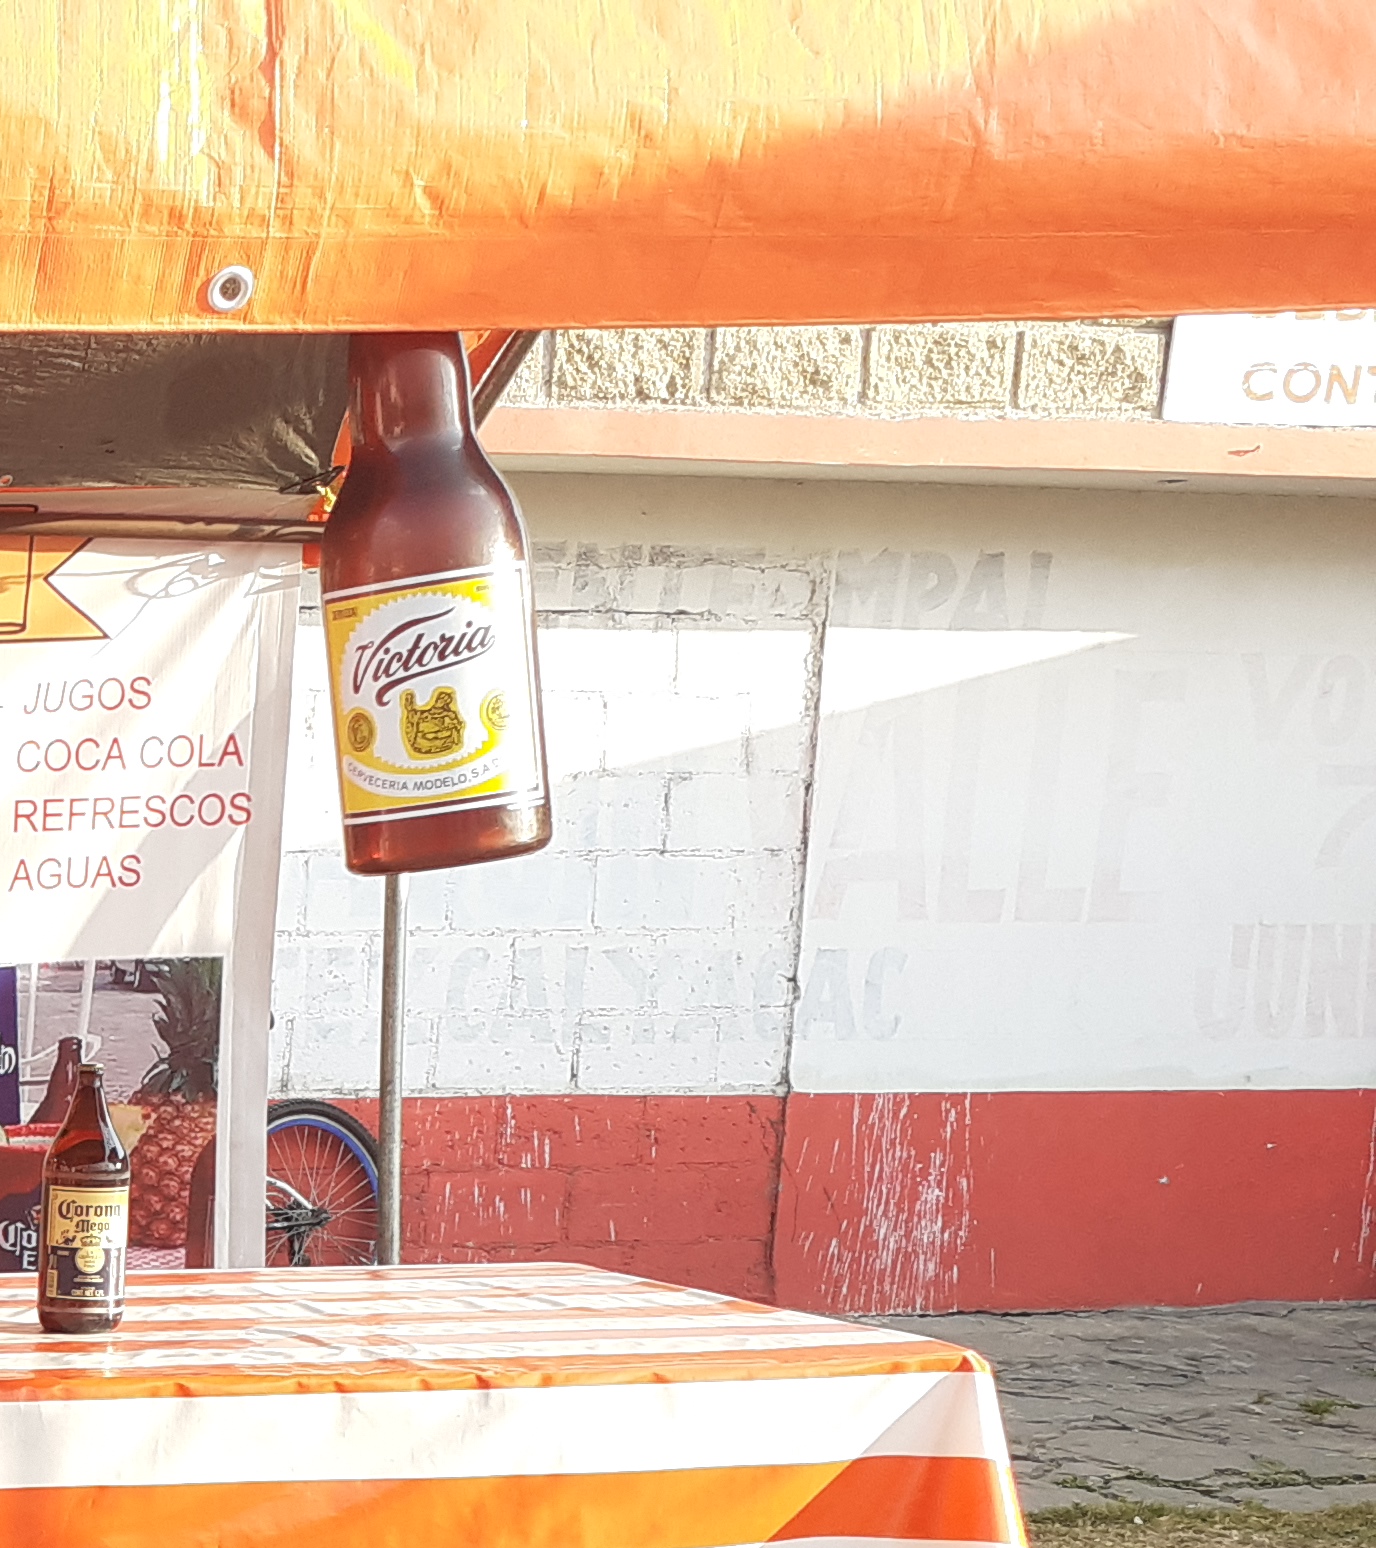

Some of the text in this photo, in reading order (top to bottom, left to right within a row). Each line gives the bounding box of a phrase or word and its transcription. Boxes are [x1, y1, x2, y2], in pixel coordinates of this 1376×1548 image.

[1241, 361, 1376, 405] CON
[351, 606, 496, 708] Victoria
[24, 676, 154, 716] JUGOS
[16, 733, 245, 774] COCA COLA
[11, 791, 254, 835] REFRESCOS
[8, 853, 143, 894] AGUAS
